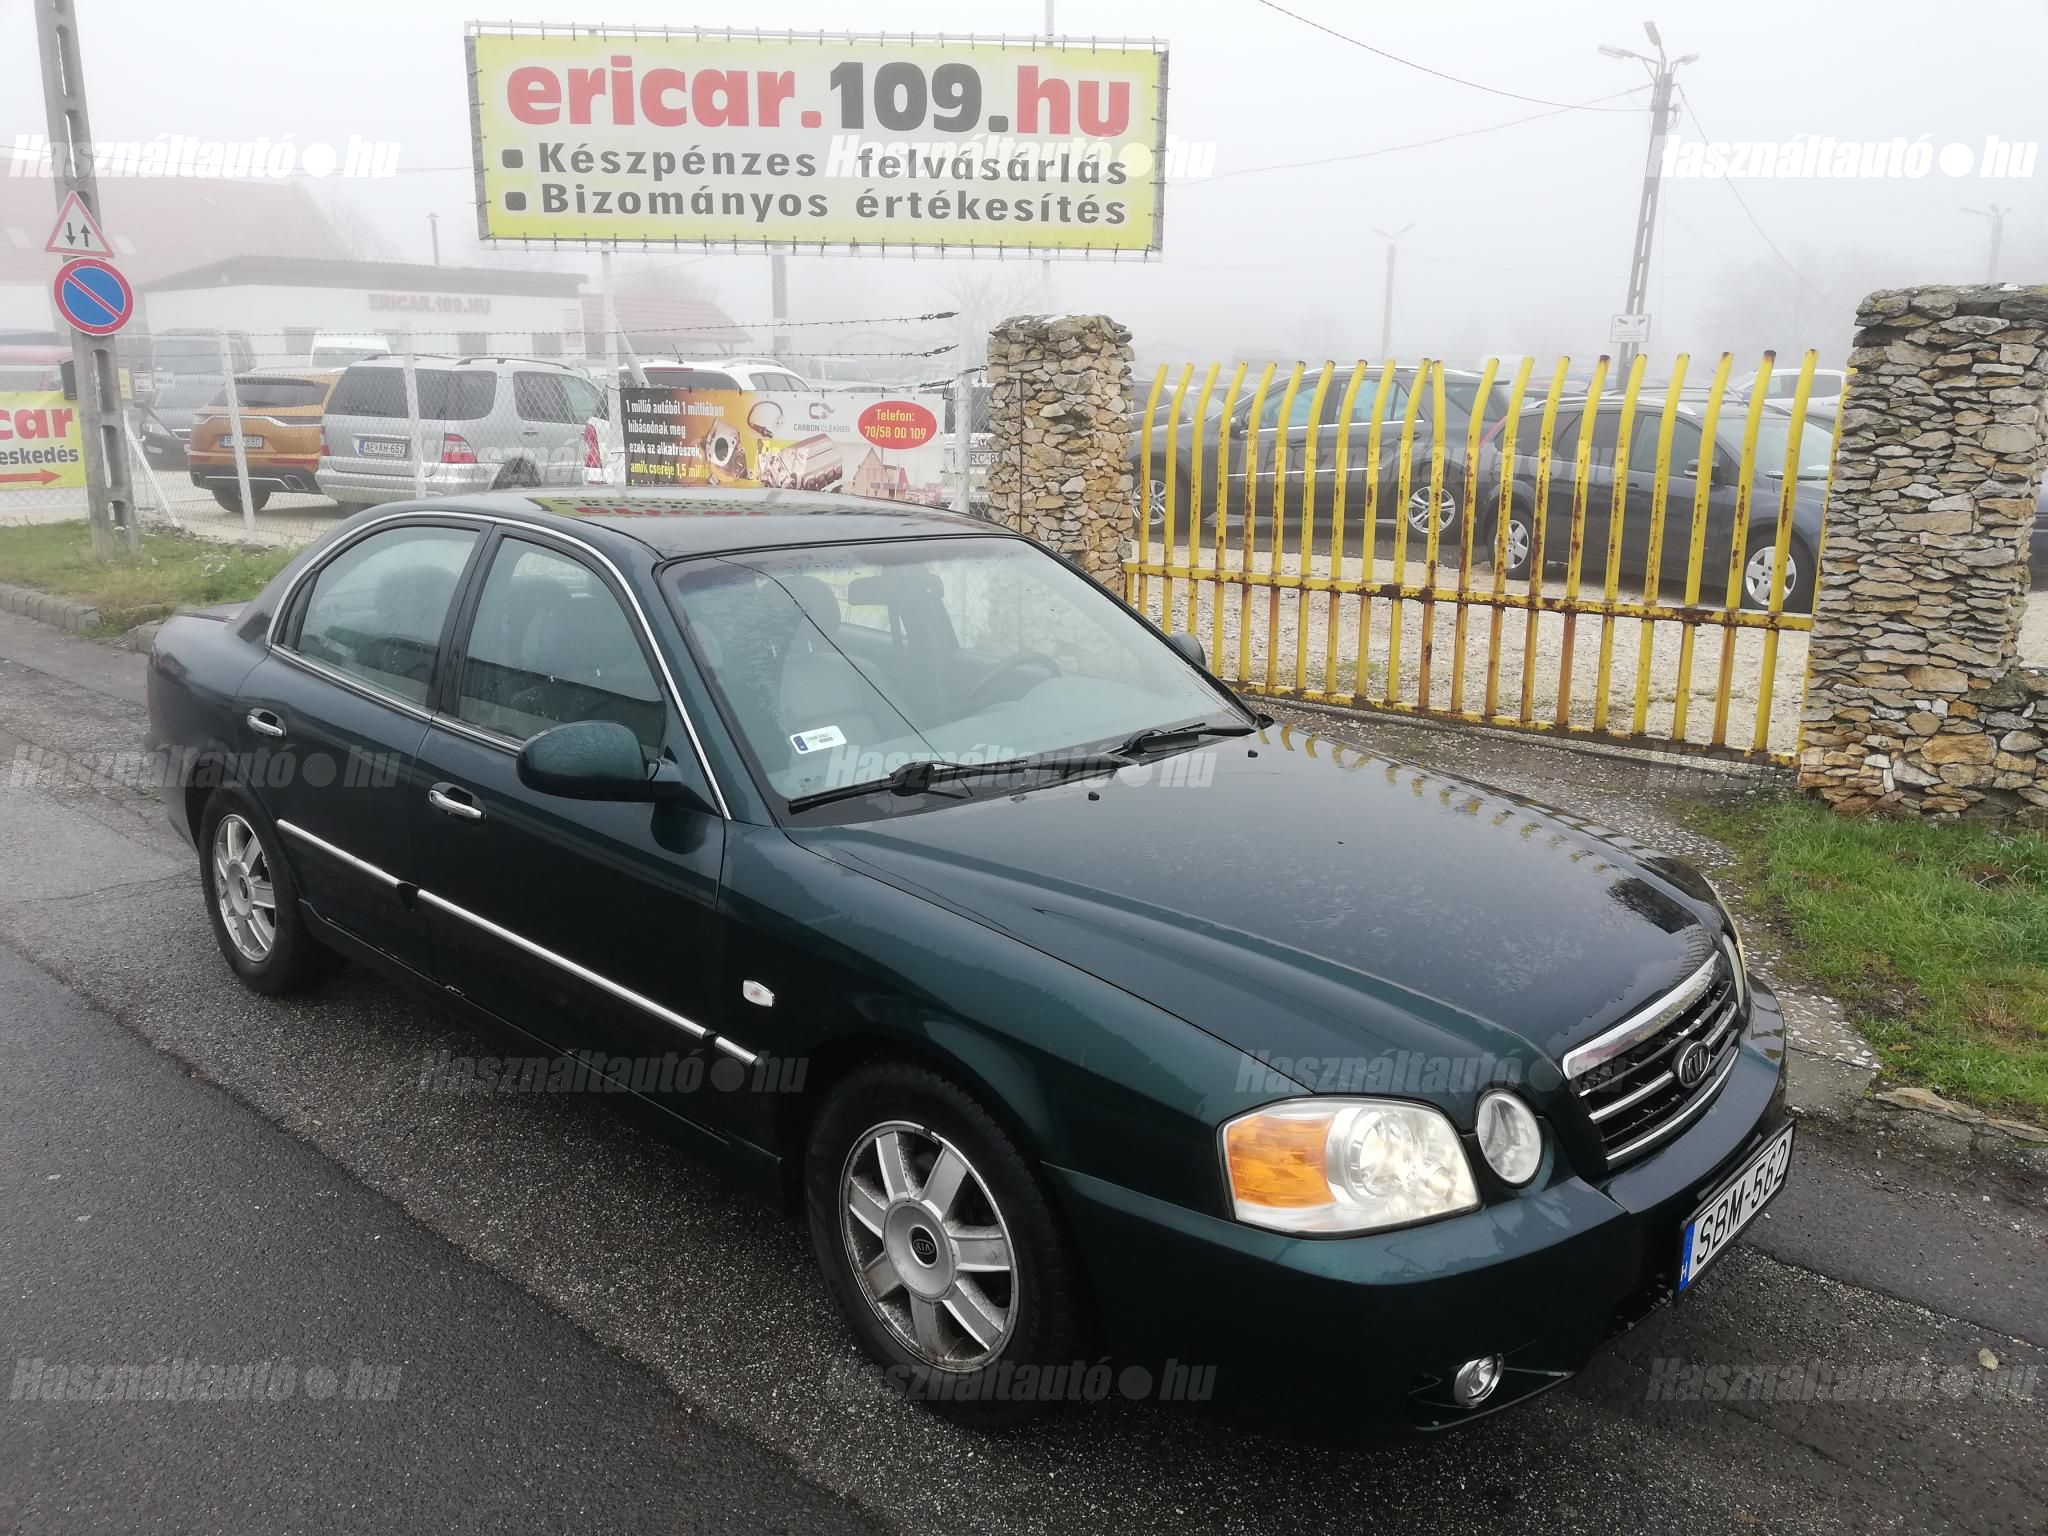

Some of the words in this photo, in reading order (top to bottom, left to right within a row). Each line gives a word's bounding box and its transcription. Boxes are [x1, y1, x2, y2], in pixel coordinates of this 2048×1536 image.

[507, 55, 1130, 137] ericar.109.hu
[540, 143, 817, 183] Készpénzes
[858, 146, 1127, 186] felvásárlás
[542, 184, 829, 222] Bizományos
[856, 188, 1126, 225] értékesítés
[632, 399, 651, 413] millió
[653, 400, 680, 414] autóból
[688, 401, 724, 416] millióban
[876, 408, 915, 422] Telefon:
[628, 419, 669, 435] hibásodnak
[670, 424, 686, 439] meg
[794, 424, 820, 432] CARBON
[820, 424, 850, 433] CLEANER
[865, 425, 891, 438] 70/58
[894, 427, 906, 439] 00
[910, 427, 927, 439] 109
[0, 445, 78, 465] eskedés
[629, 440, 646, 454] ezek
[647, 445, 655, 454] az
[657, 441, 702, 458] alkatrészek,
[630, 461, 648, 473] amik
[649, 461, 674, 478] cseréje
[676, 463, 686, 478] 1,5
[1696, 1138, 1787, 1265] SBM-562
